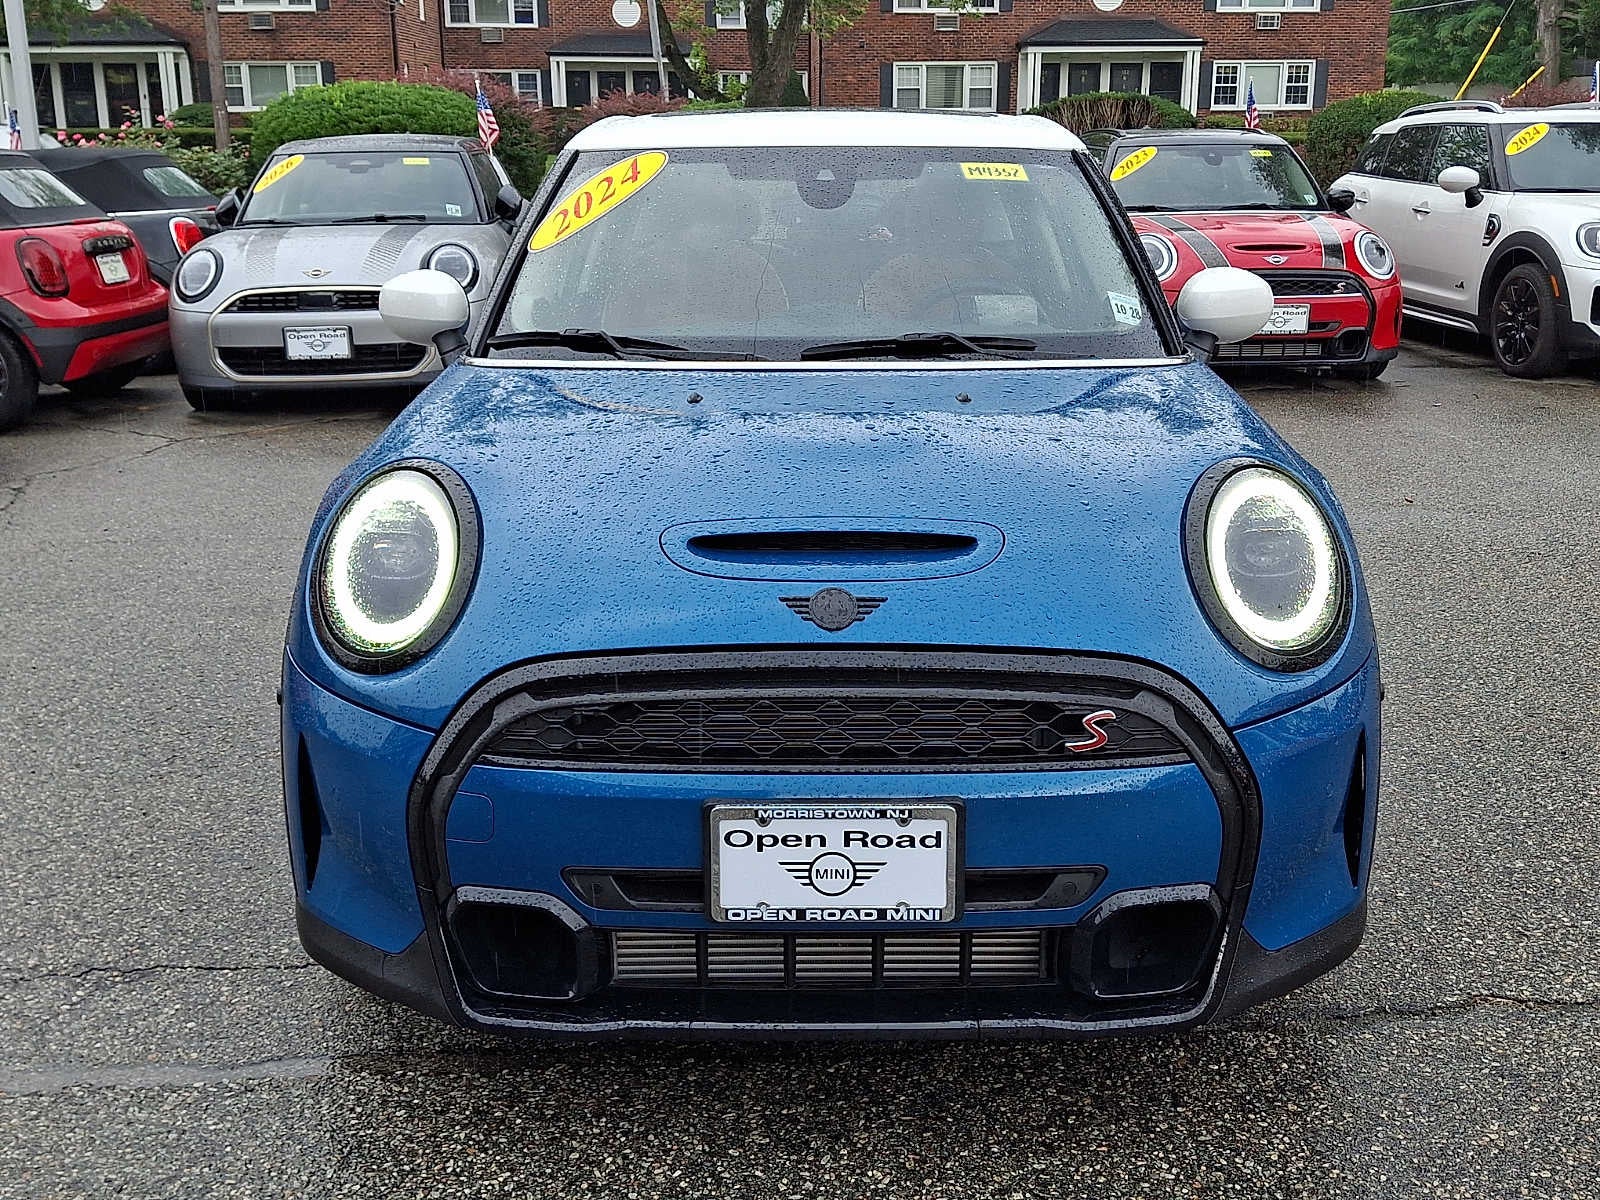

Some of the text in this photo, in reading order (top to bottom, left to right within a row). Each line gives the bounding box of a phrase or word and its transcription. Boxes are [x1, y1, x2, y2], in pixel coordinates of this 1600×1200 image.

[1511, 126, 1541, 152] 2024
[1119, 150, 1149, 176] 2023
[552, 155, 641, 239] 2024
[1114, 303, 1142, 320] 10 28
[288, 333, 316, 341] Open
[1065, 710, 1116, 752] S
[757, 809, 909, 819] MORRISTOWN, NJ
[723, 829, 942, 852] Open Road
[815, 867, 850, 880] MINI
[727, 909, 941, 921] OPEN ROAD MINI
